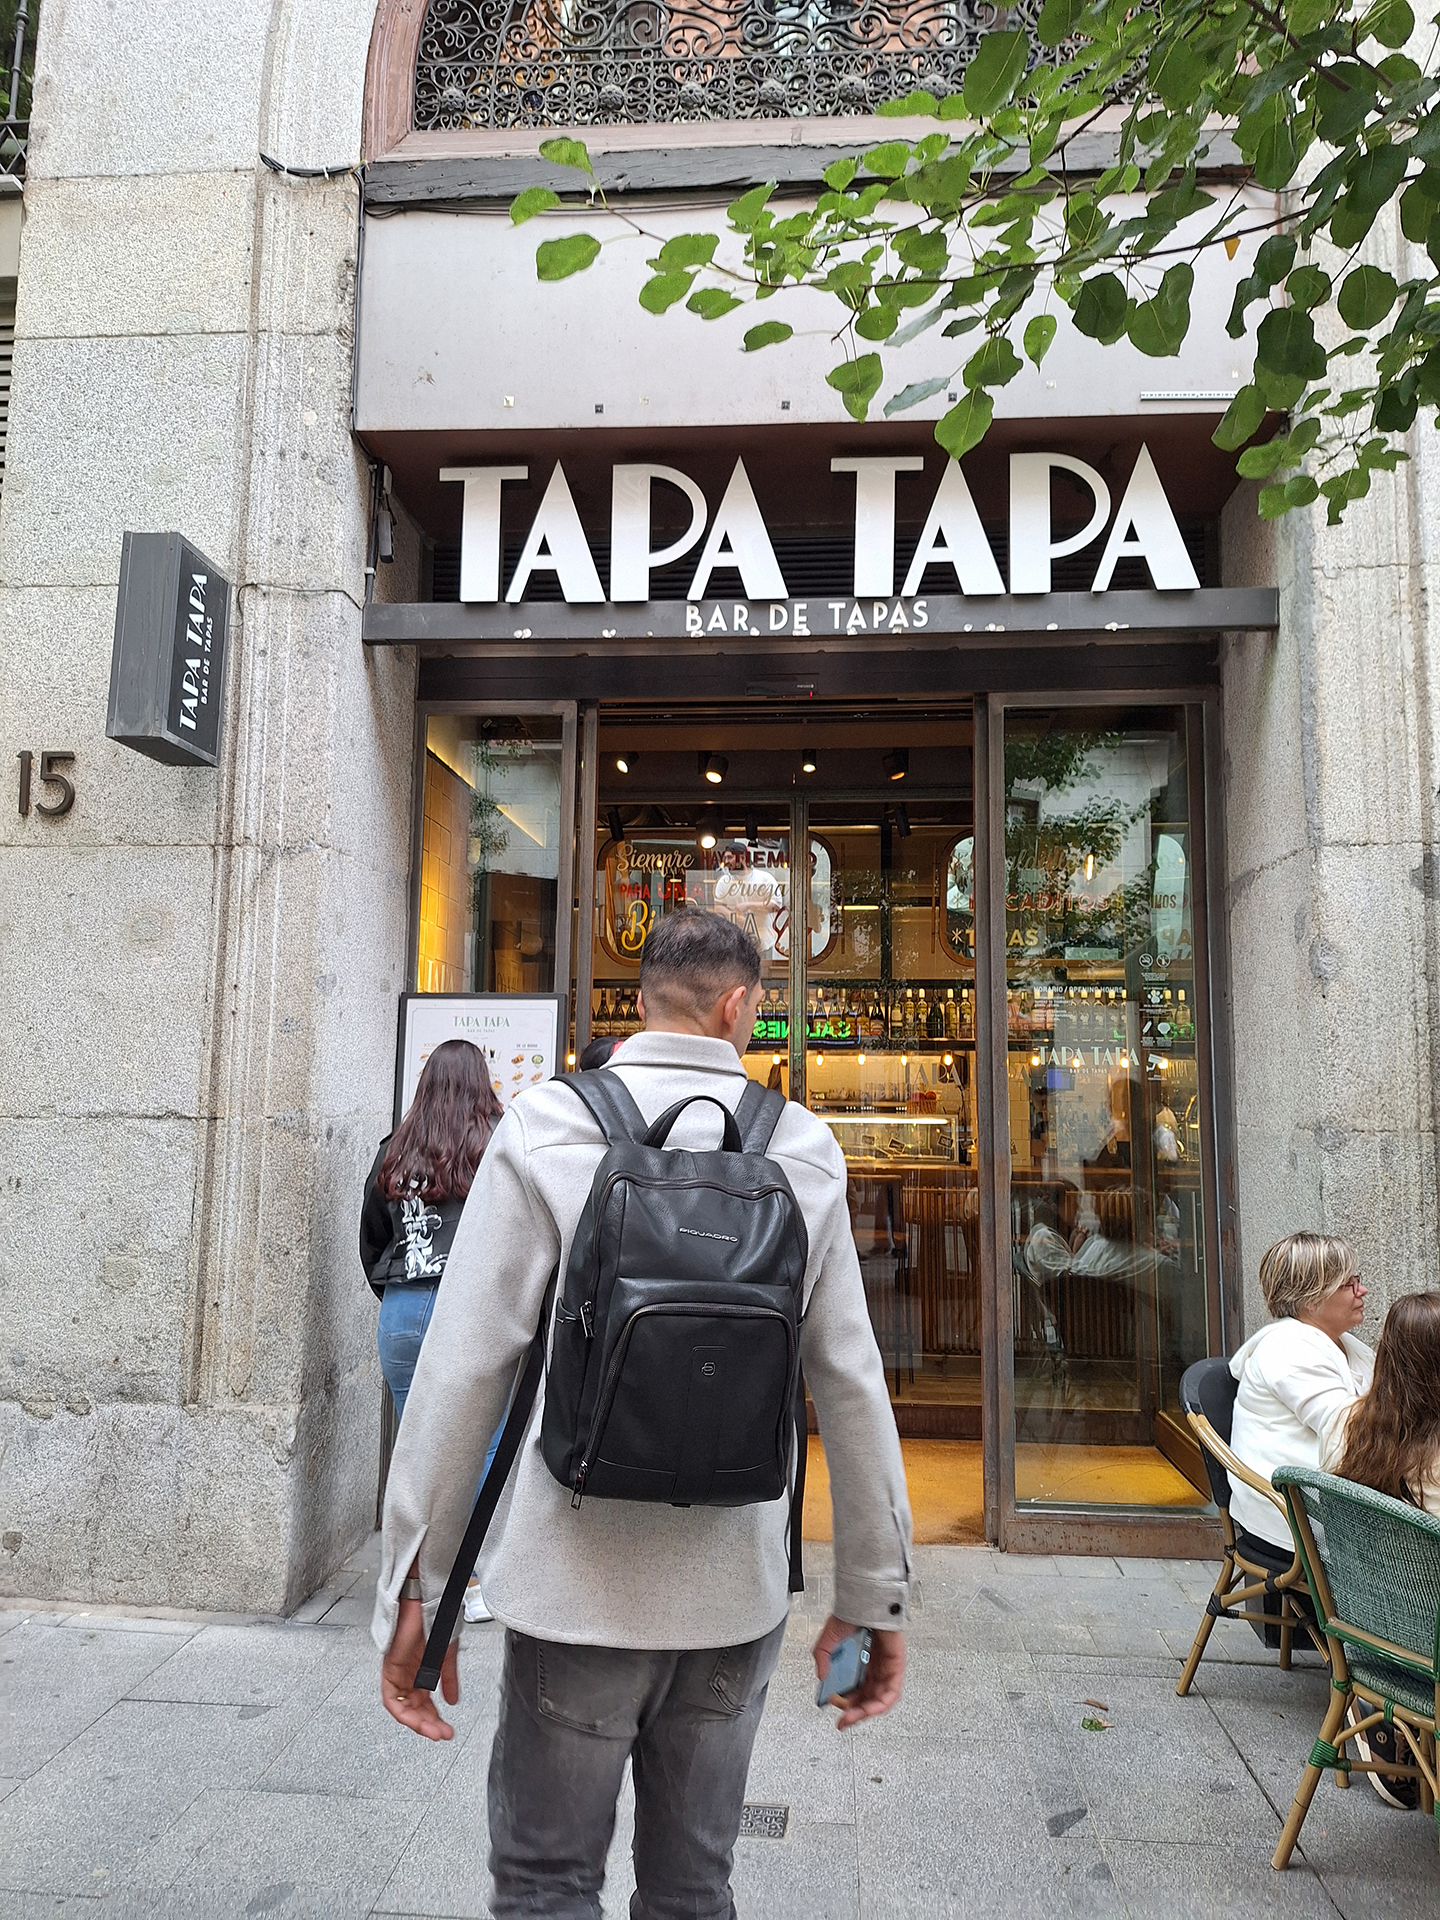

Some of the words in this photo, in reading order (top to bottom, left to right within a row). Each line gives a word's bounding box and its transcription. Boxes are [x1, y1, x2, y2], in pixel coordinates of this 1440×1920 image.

[438, 455, 789, 605] TAPA
[830, 441, 1202, 598] TAPA
[186, 573, 208, 647] TAPA
[685, 604, 750, 632] BAR
[769, 602, 808, 631] DE
[828, 600, 929, 630] TAPAS
[204, 616, 213, 653] TAPAS
[203, 657, 211, 675] DE
[179, 658, 202, 732] TAPA
[200, 678, 209, 705] BAR
[17, 750, 75, 816] 15
[616, 844, 695, 877] Siempre
[733, 851, 818, 868] TIEMO
[618, 883, 651, 899] PARA
[657, 881, 705, 900] UNA
[453, 1016, 480, 1028] TAPA
[483, 1016, 510, 1028] TAPA
[1037, 1046, 1086, 1066] TAPA
[1091, 1046, 1140, 1066] TAPA
[678, 1227, 739, 1243] PIQUADRO
